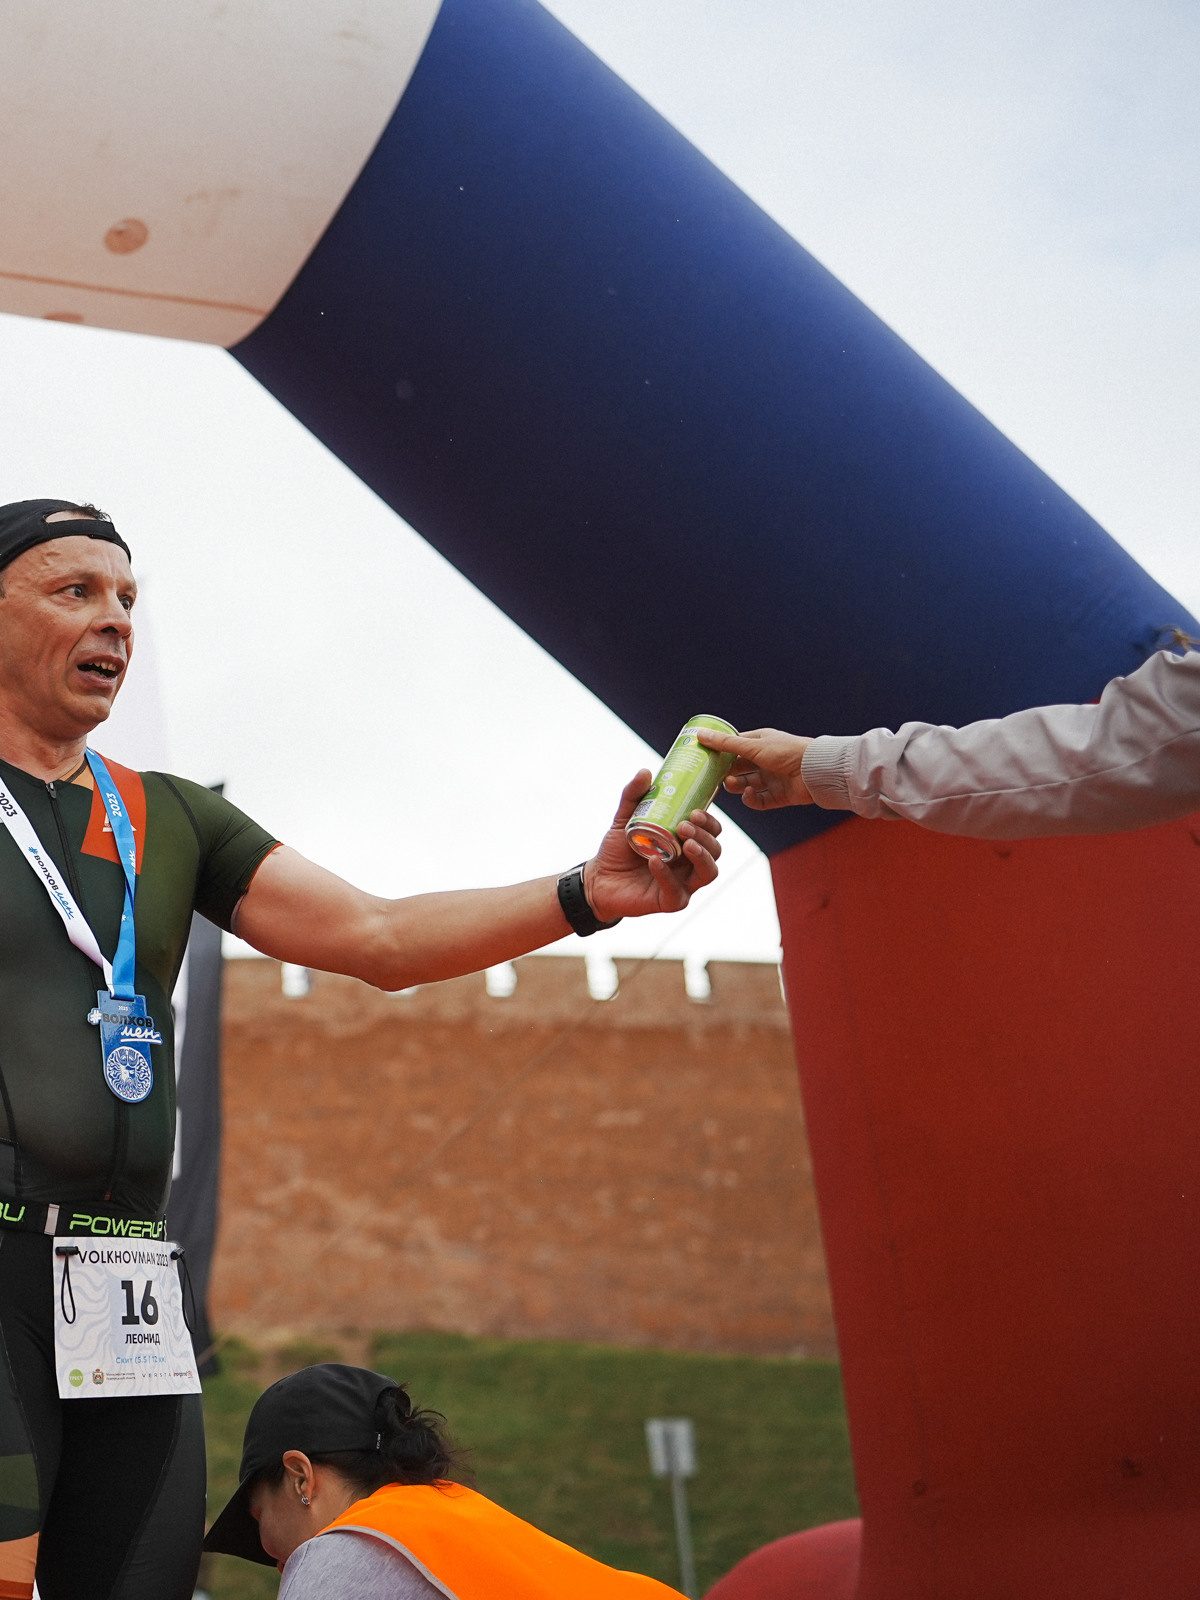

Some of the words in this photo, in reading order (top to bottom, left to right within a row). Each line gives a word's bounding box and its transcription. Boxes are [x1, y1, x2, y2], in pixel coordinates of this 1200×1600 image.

[106, 792, 122, 818] 2023
[79, 1250, 156, 1265] VOLKHOVMAN
[156, 1253, 169, 1267] 2023
[121, 1280, 158, 1325] 16
[125, 1333, 160, 1345] ЛЕОНИД
